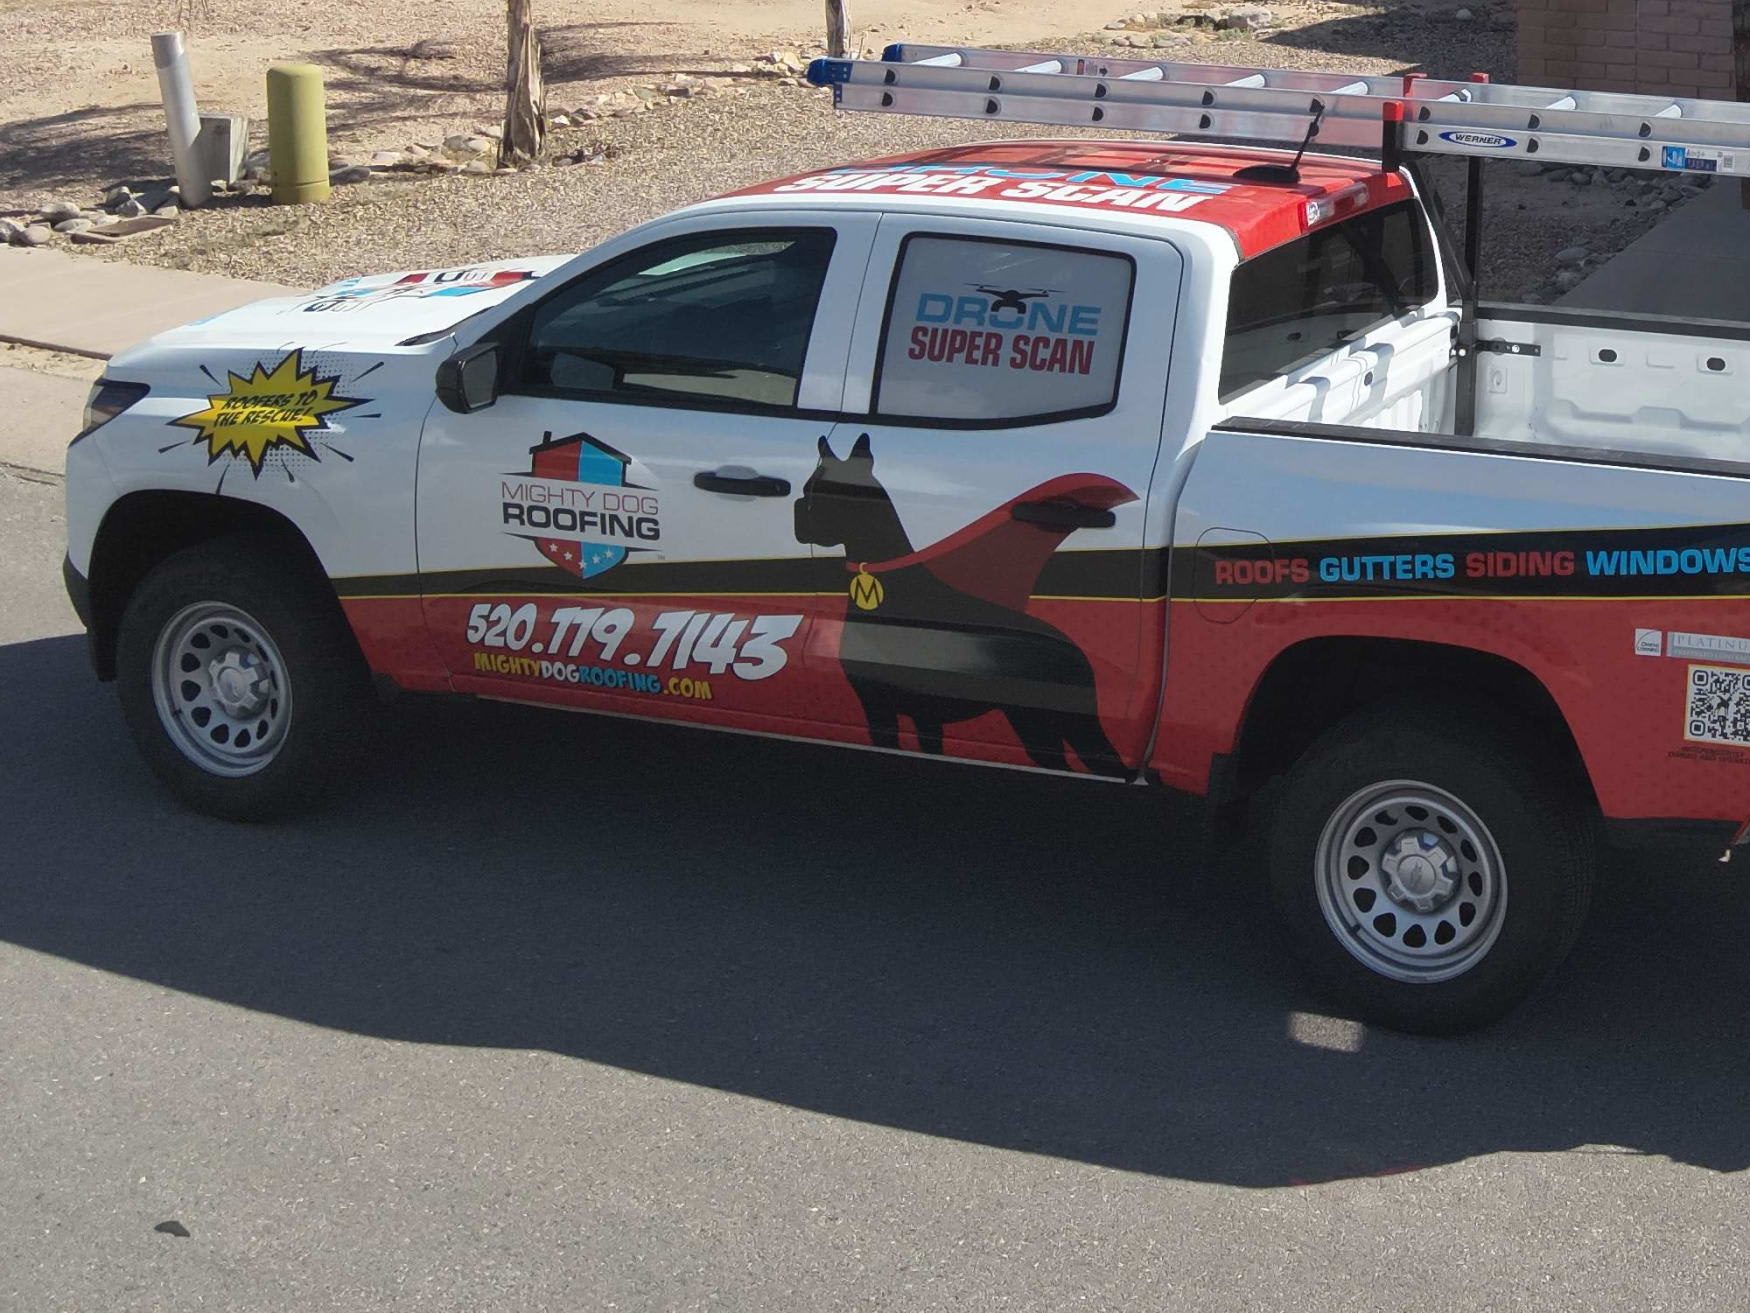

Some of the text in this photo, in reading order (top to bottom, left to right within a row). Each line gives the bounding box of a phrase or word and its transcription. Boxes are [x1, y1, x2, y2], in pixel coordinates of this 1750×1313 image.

[1454, 133, 1502, 145] WERNER
[773, 172, 1214, 213] SUPER SCAN
[915, 292, 1102, 336] DRONE
[908, 325, 1095, 375] SUPER SCAN
[213, 407, 313, 428] THE RESCUE!
[221, 389, 318, 410] ROOFERS TO
[501, 480, 659, 516] MIGHTY DOG
[502, 501, 661, 541] ROOFING
[1214, 558, 1310, 585] ROOFS
[1319, 553, 1455, 583] GUTTERS
[1465, 551, 1575, 578] SIDING
[465, 602, 804, 681] 520.779.7143
[473, 651, 714, 701] MIGHTYDOGROOFING.COM
